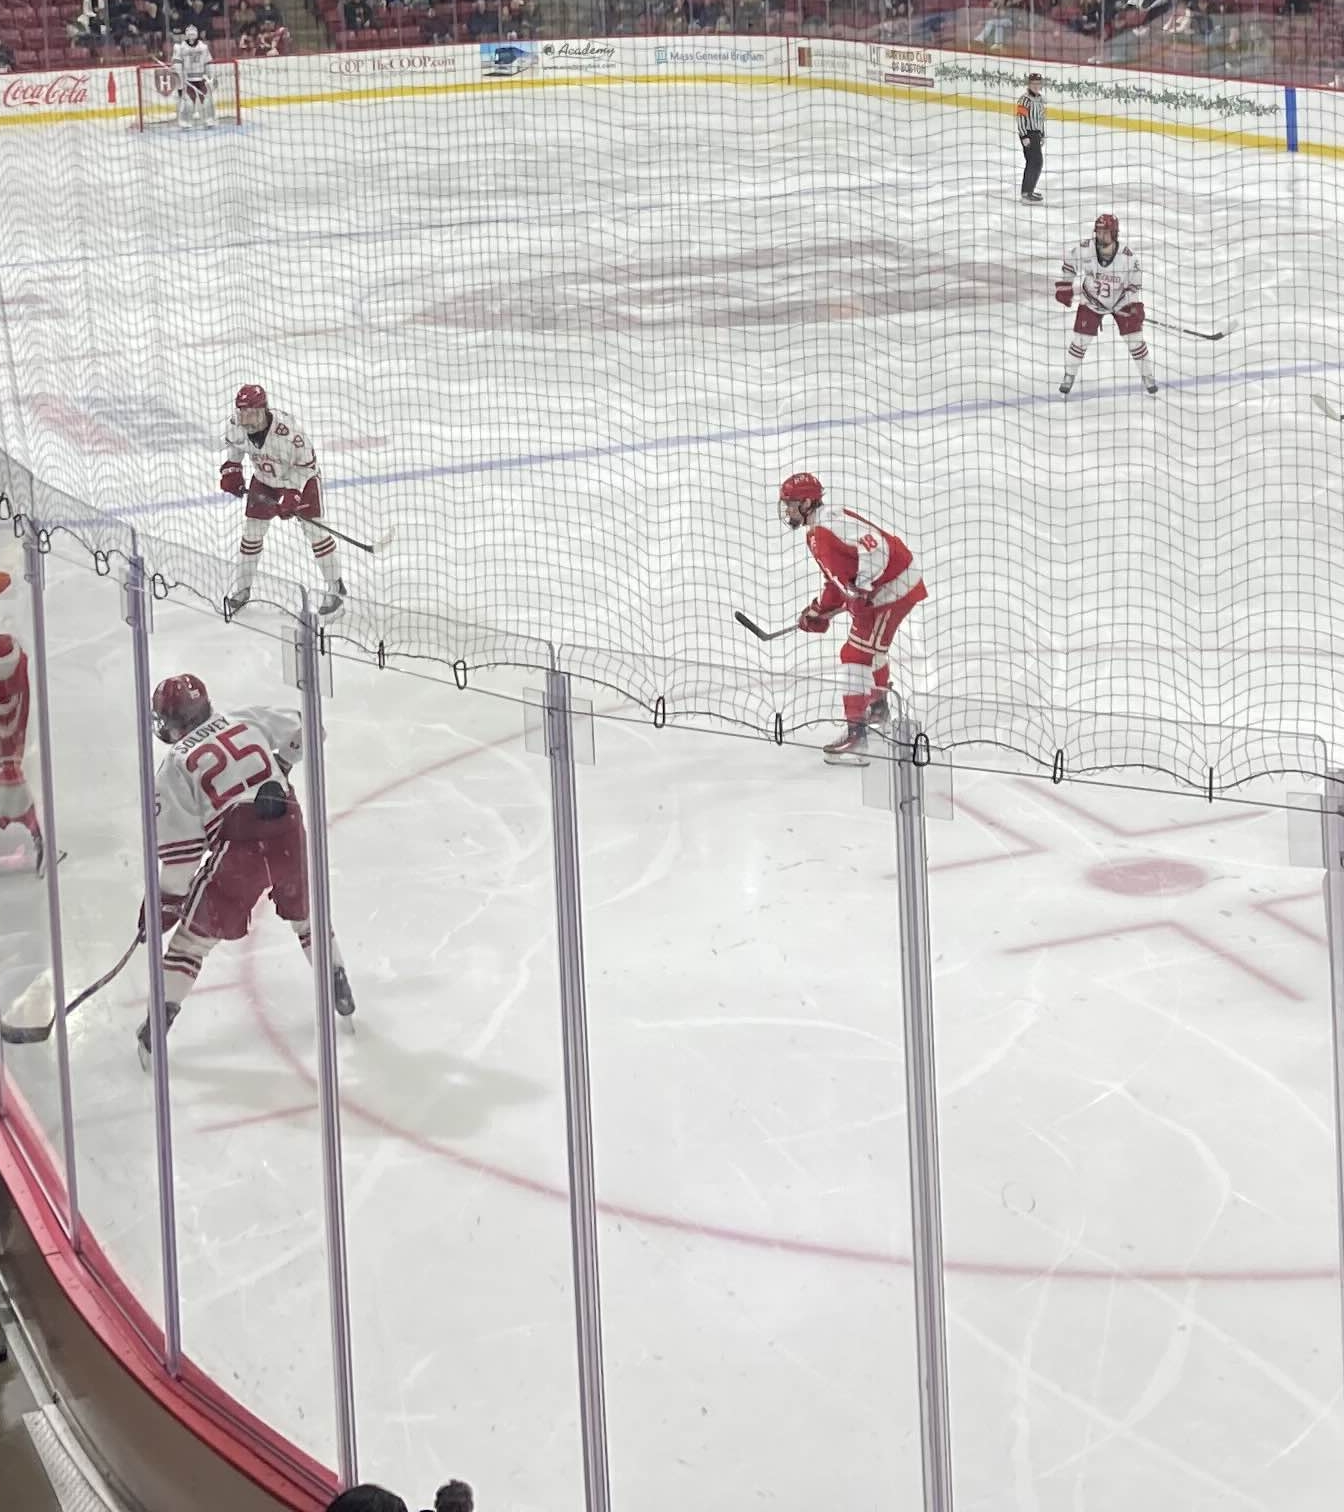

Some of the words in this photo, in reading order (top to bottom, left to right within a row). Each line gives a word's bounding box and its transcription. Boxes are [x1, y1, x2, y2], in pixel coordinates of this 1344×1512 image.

[558, 42, 615, 58] Academy
[670, 51, 693, 61] Mass
[696, 51, 729, 61] General
[731, 51, 765, 64] Brigham
[1093, 280, 1111, 298] 33
[859, 533, 878, 552] 18
[174, 716, 231, 755] SOLOVEY
[186, 722, 272, 811] 25
